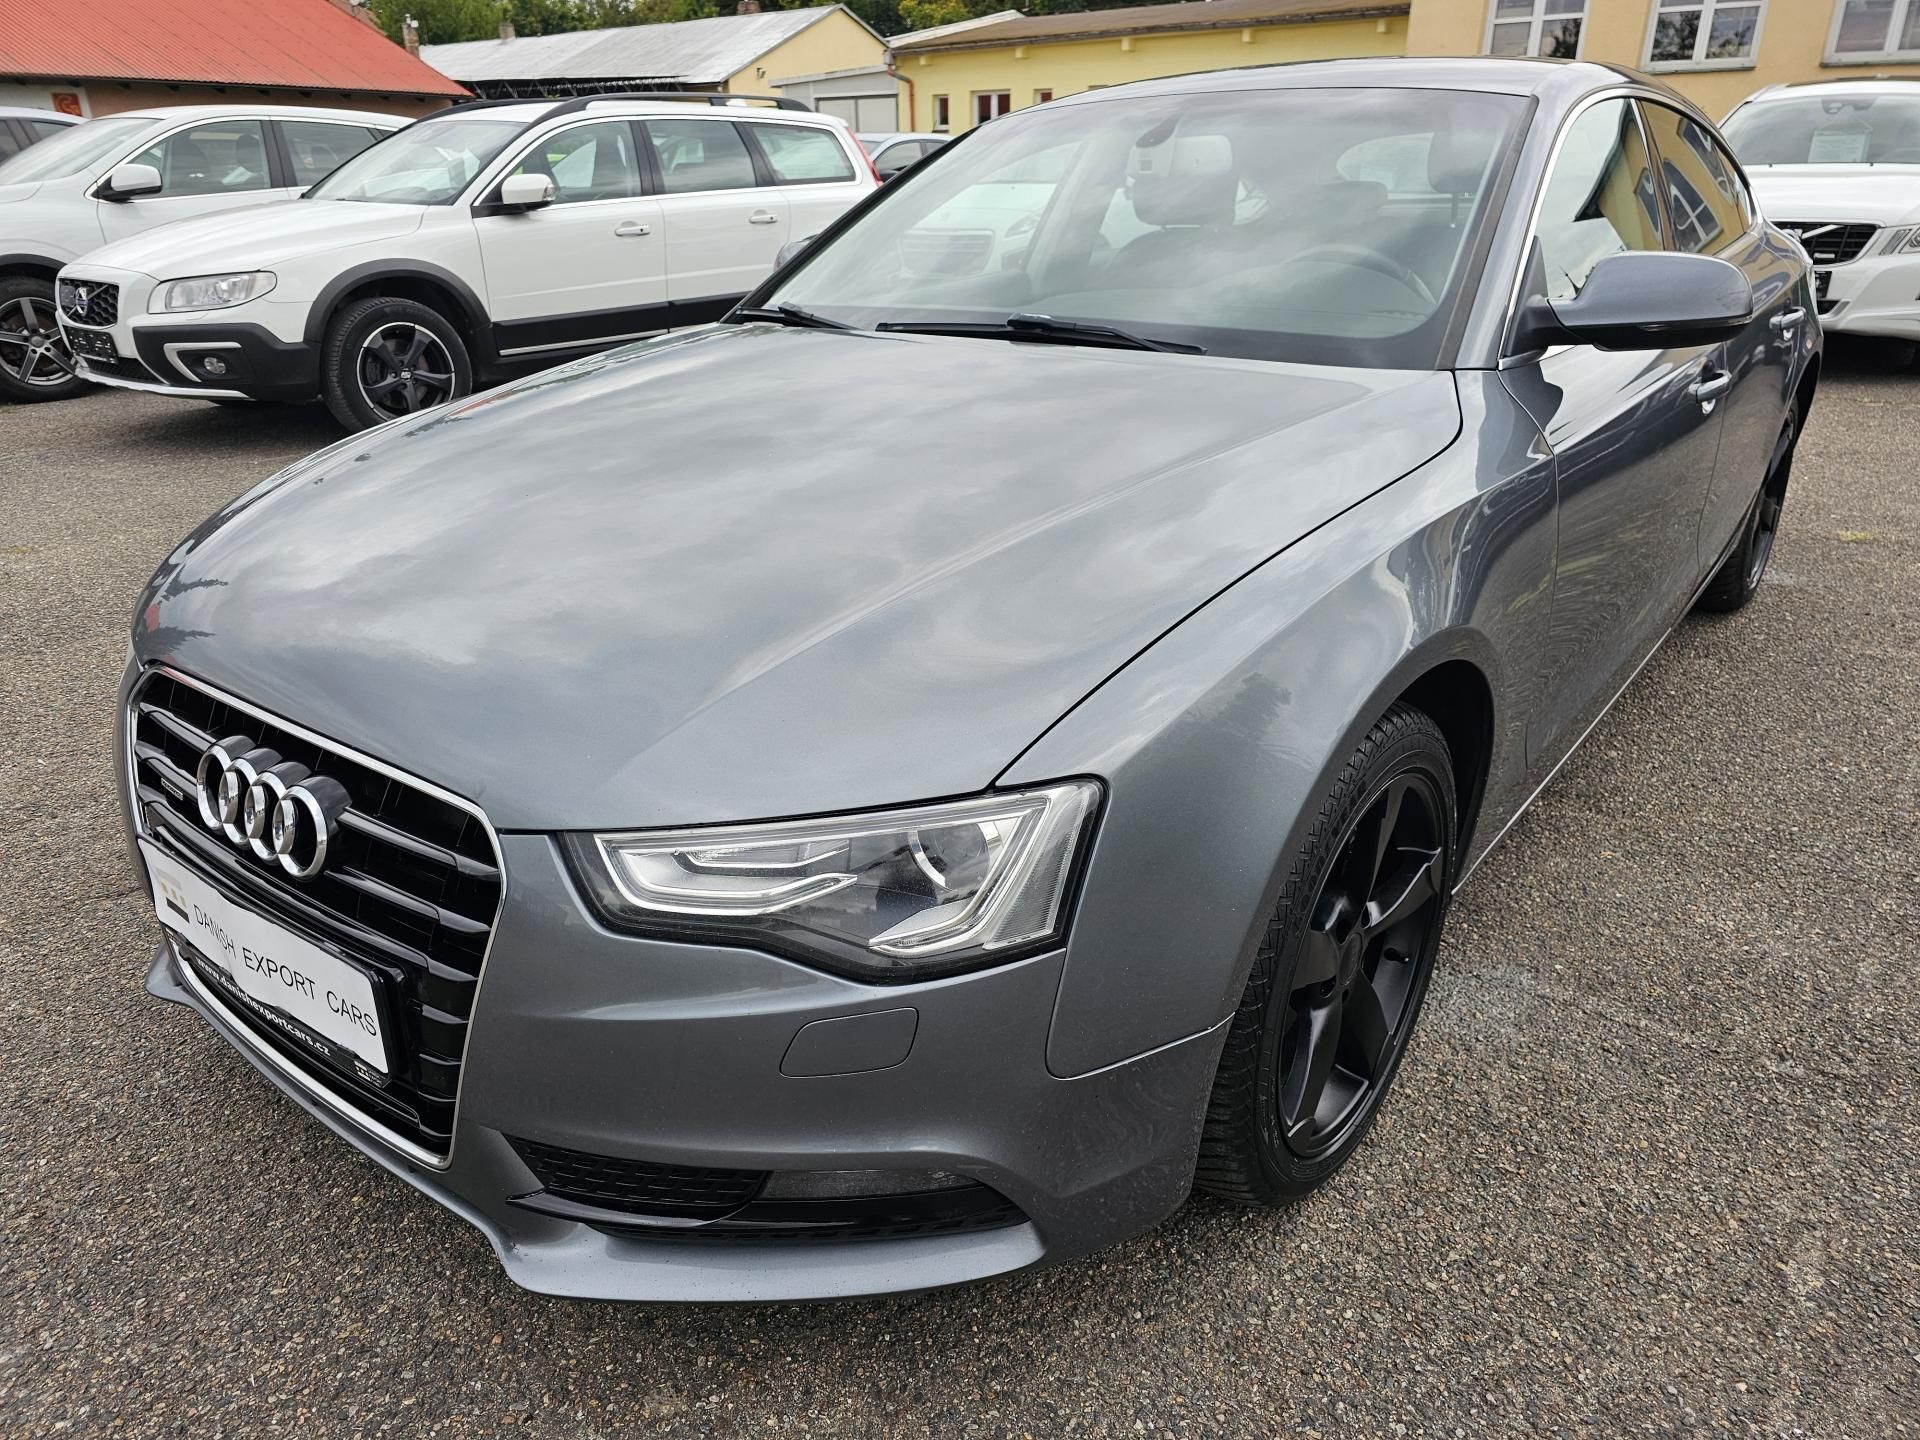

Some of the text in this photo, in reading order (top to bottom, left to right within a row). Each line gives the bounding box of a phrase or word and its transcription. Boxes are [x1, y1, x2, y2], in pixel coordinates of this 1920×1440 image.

[193, 904, 377, 1036] DANISH EXPORT CARS
